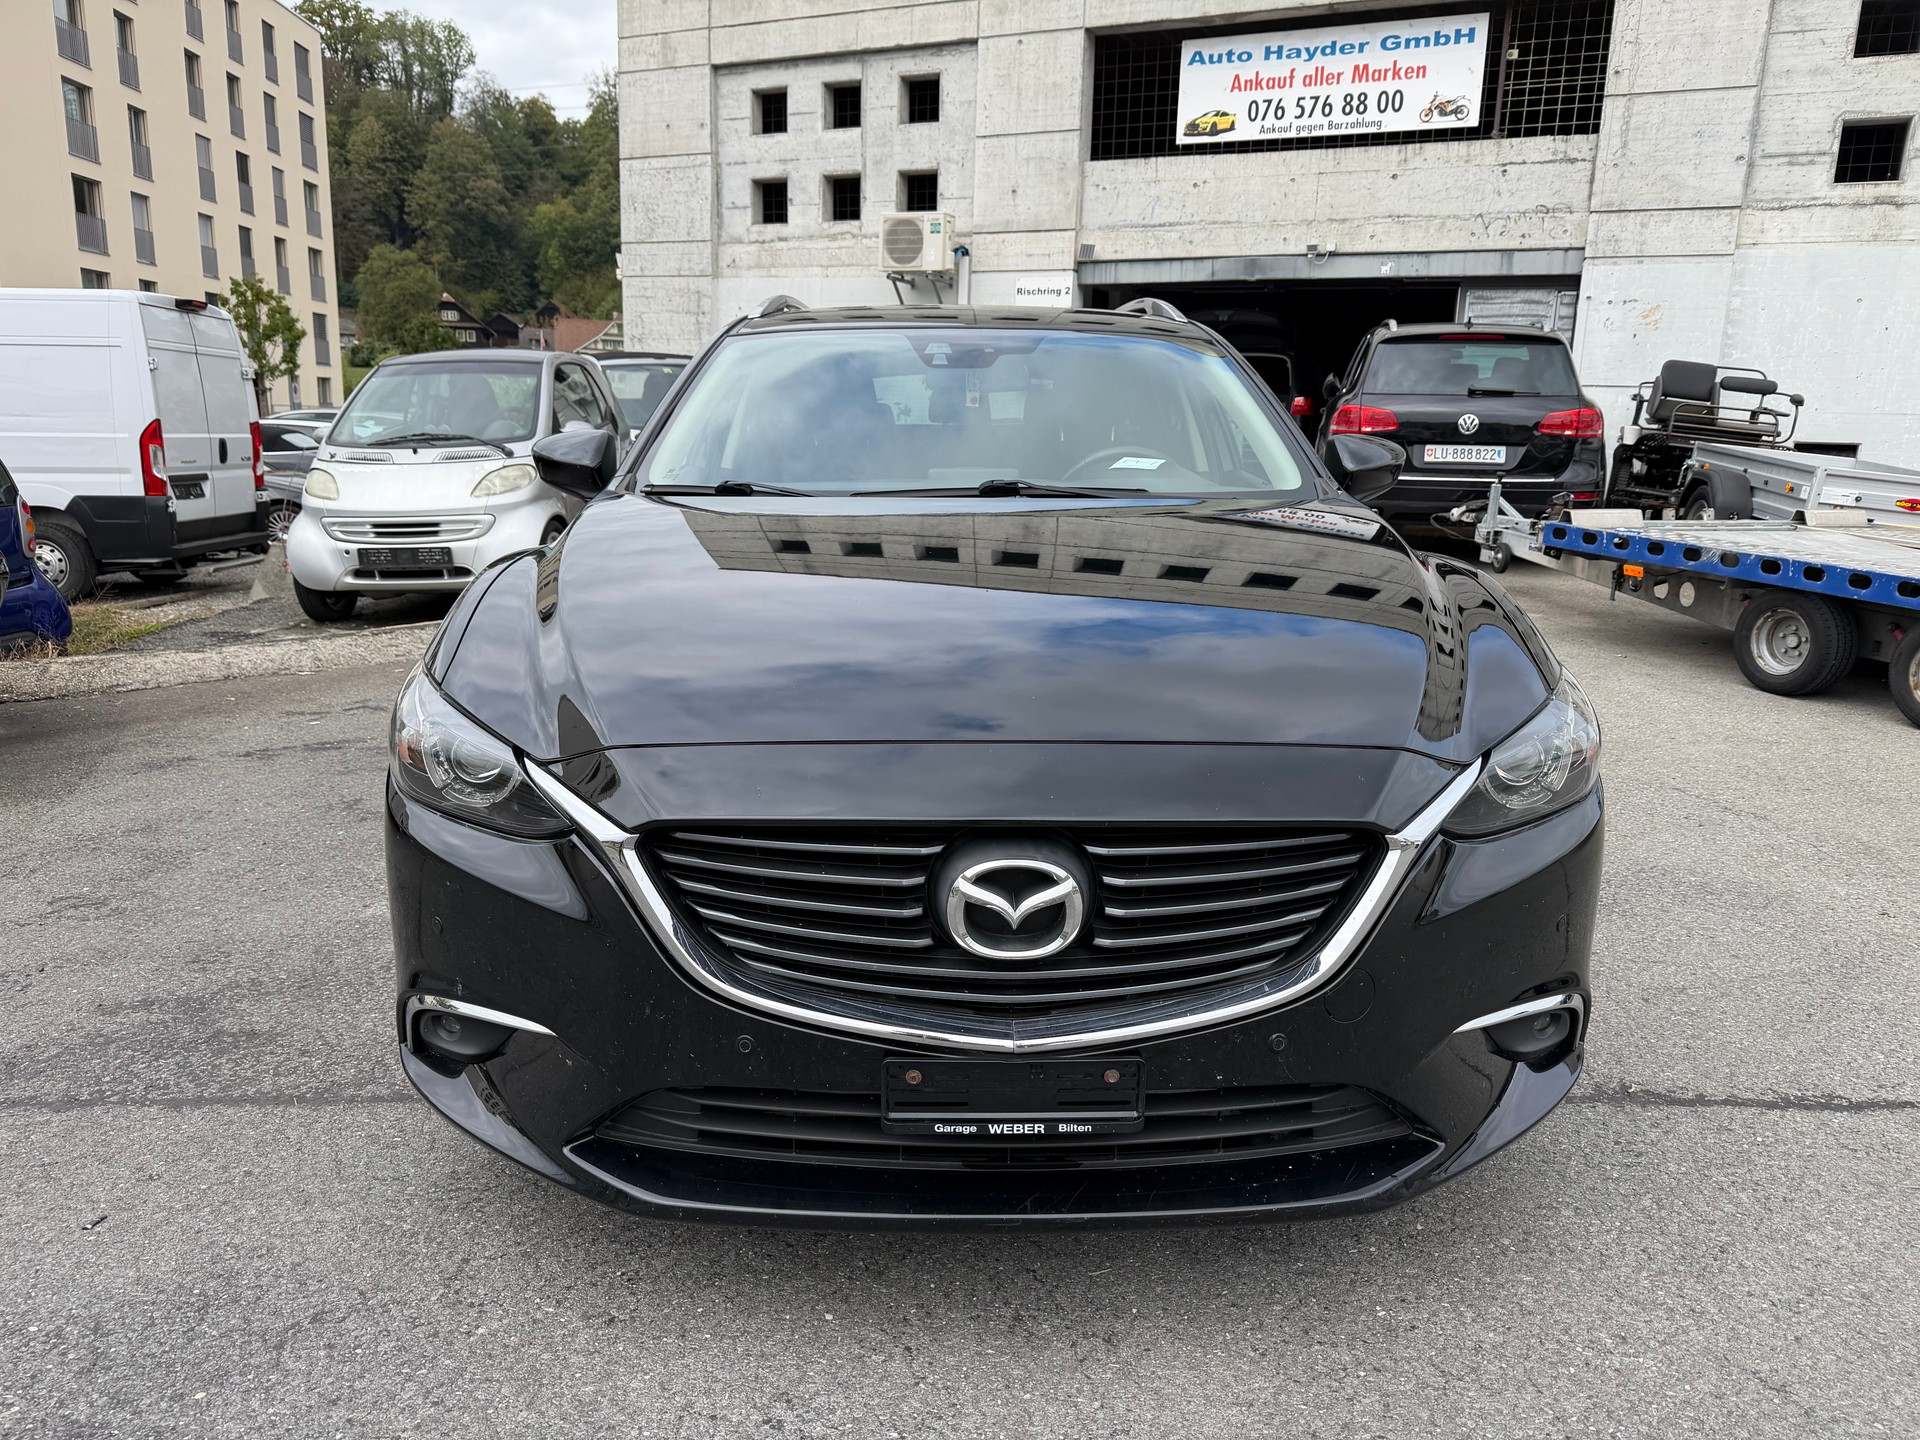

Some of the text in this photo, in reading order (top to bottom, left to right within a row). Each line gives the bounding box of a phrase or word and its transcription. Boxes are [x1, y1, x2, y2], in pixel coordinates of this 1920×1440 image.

[1187, 27, 1477, 66] Auto Hayder GmbH
[1229, 60, 1427, 93] Ankauf aller Marken
[1247, 89, 1405, 122] 076 576 88 00
[1259, 117, 1383, 135] Ankauf gegen Barzahlung
[1016, 286, 1071, 297] Rischring 2
[934, 1123, 1092, 1134] Garage WEBER Bilten
